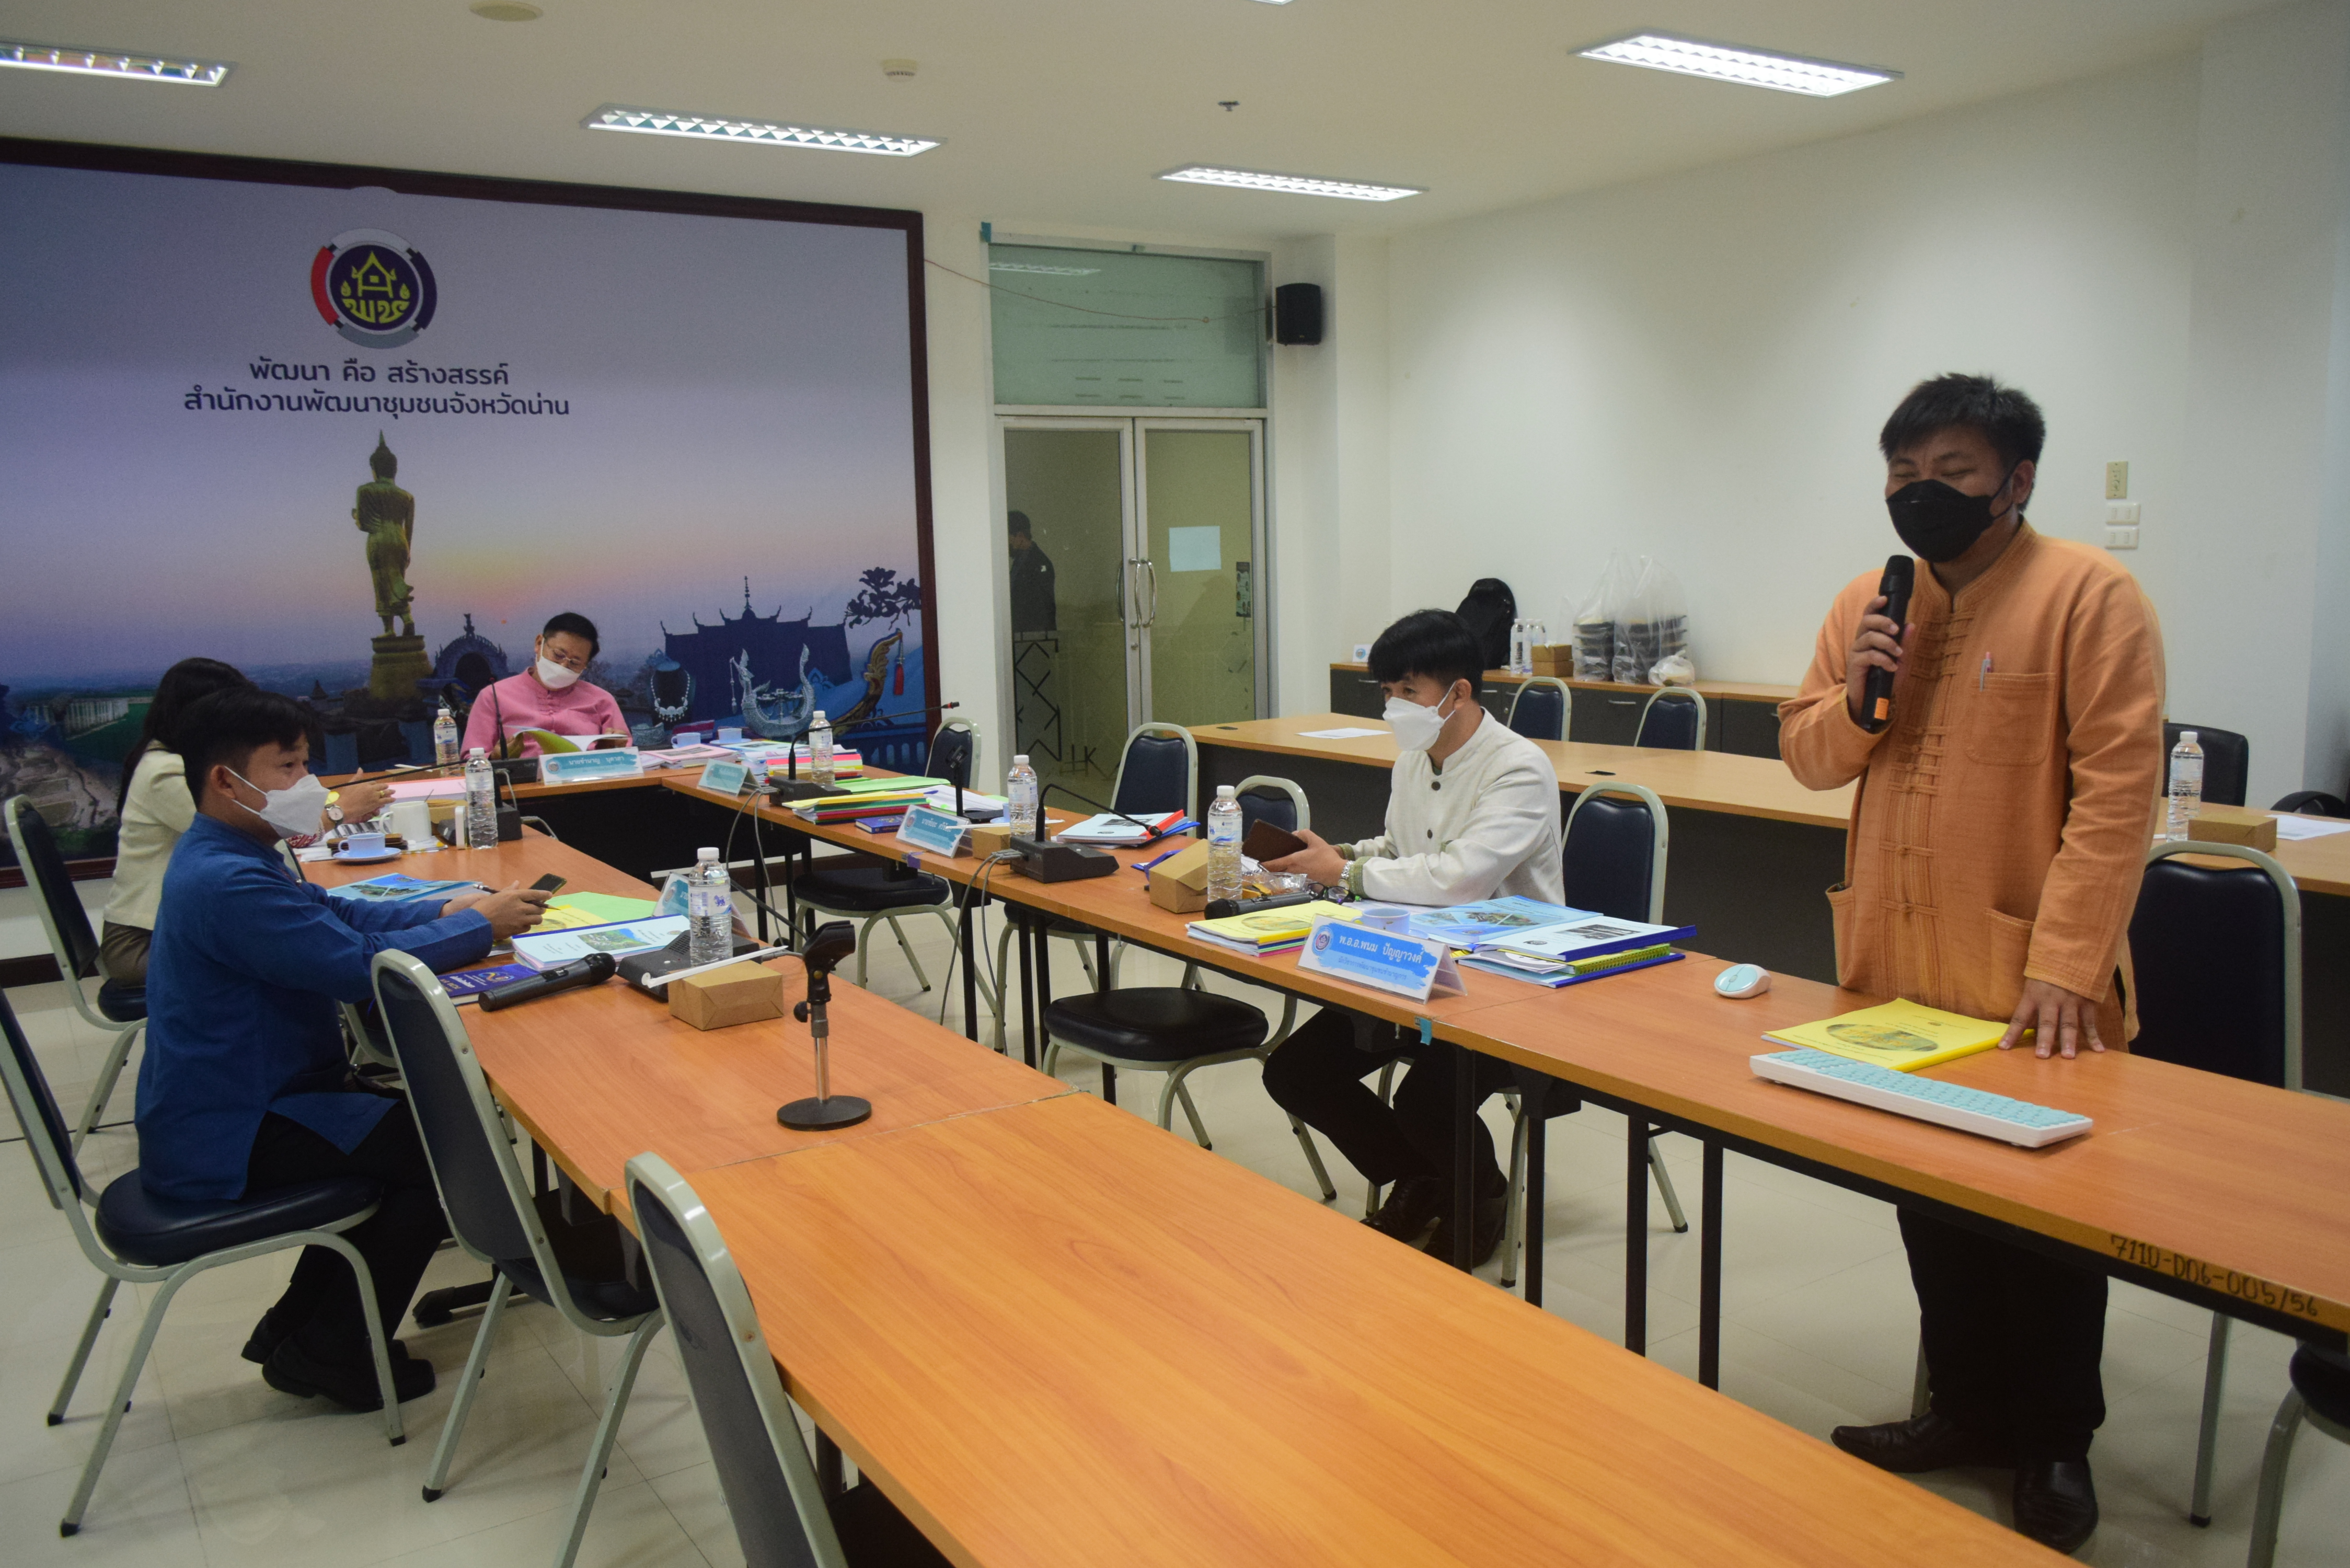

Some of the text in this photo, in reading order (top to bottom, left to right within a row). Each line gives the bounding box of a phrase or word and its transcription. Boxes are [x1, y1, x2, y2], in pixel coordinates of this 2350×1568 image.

[249, 355, 509, 385] พัฒนา คือ สร้างสรรค์
[184, 384, 570, 420] สำนักงานพัฒนาชุมชนจังหวัดน่าน
[1339, 935, 1423, 963] พ.อ.อ.พนม ปัญญาวงค์
